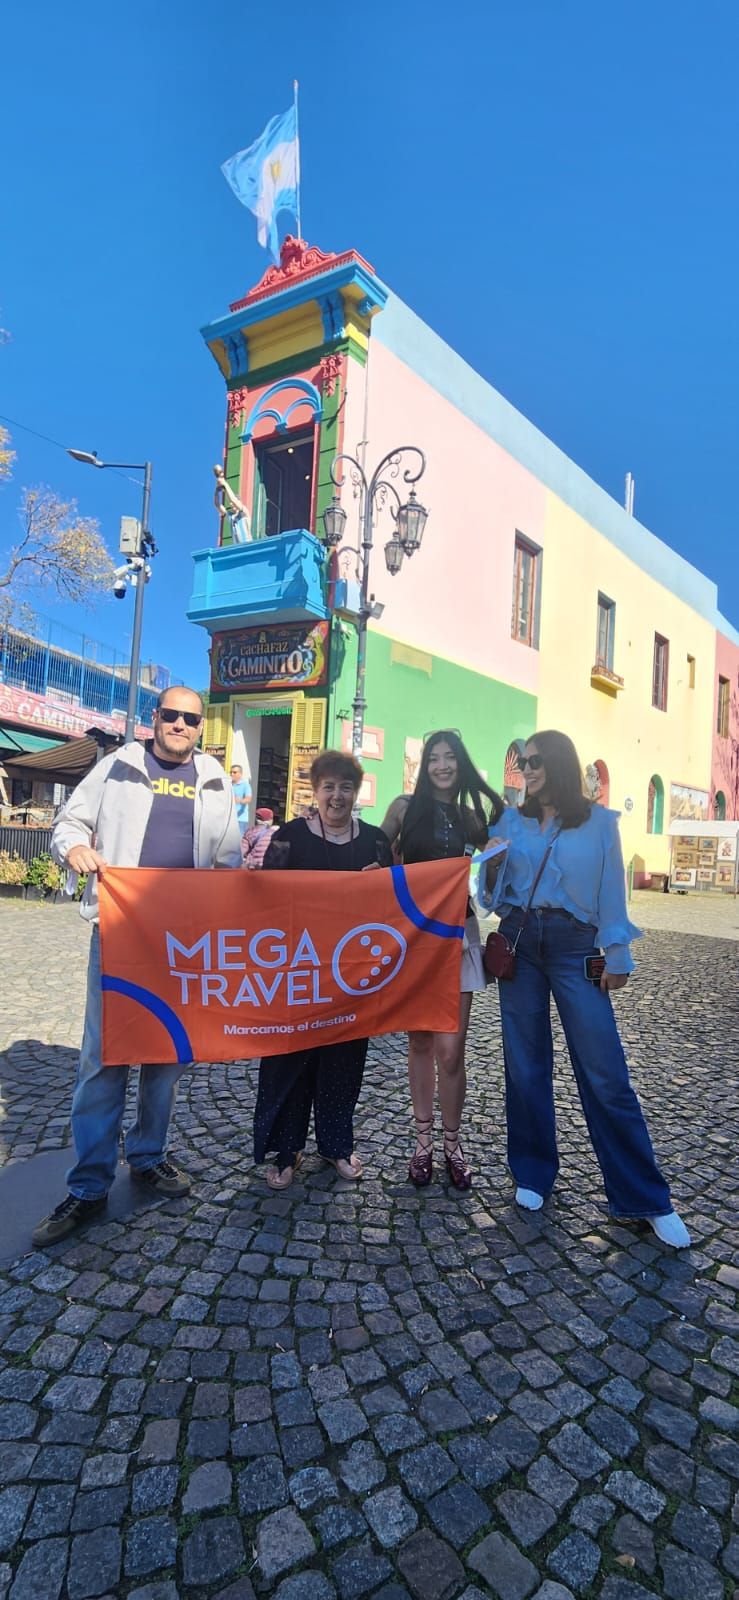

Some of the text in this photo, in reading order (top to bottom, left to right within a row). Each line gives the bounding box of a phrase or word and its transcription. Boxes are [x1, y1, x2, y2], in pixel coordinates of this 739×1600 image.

[228, 650, 303, 678] CAMINITO
[165, 927, 321, 971] MEGA
[170, 969, 333, 1007] TRAVEL
[223, 1013, 357, 1035] Marcamos el destino
